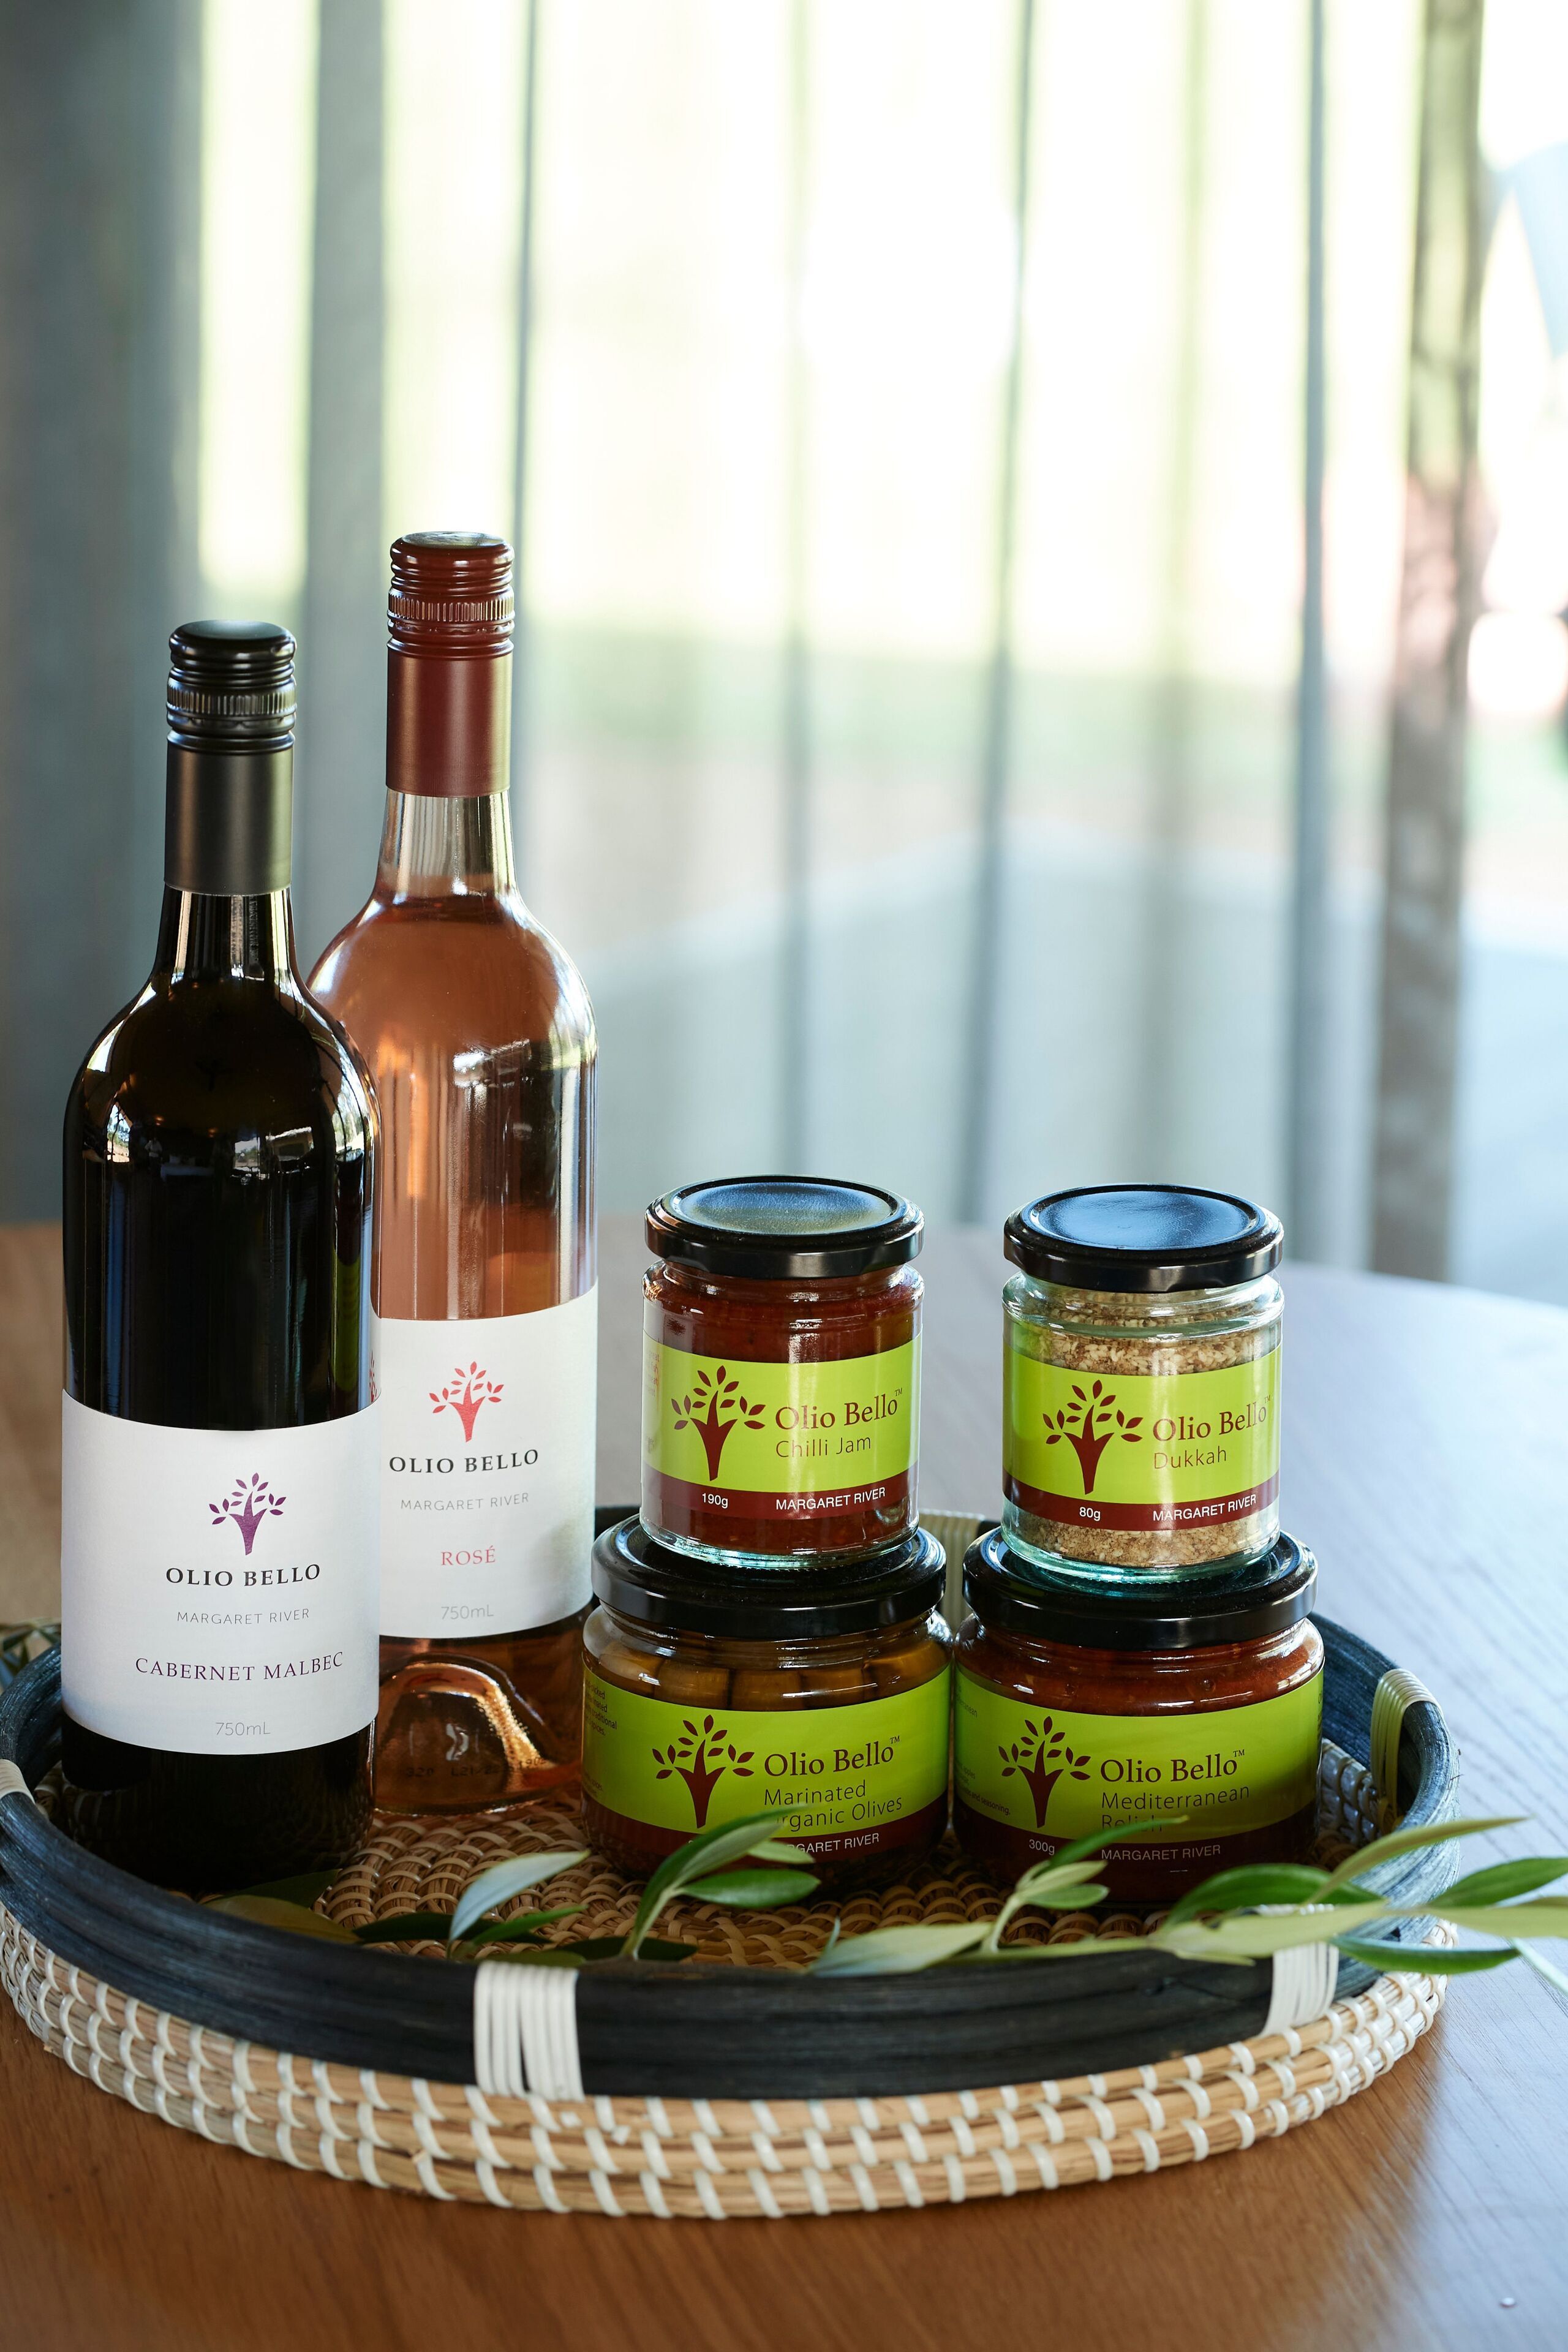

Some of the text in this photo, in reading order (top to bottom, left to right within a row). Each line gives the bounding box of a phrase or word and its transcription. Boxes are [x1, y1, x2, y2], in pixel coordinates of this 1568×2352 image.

[775, 1405, 835, 1430] Olio
[1153, 1416, 1210, 1441] Olio
[776, 1438, 871, 1457] Chilli Jam
[1155, 1446, 1226, 1469] Dukkah
[390, 1450, 538, 1473] OLIO BELLO
[401, 1493, 529, 1510] MARGARET RIVER
[703, 1493, 728, 1509] 190g
[776, 1487, 885, 1510] MARGARET RIVER
[1153, 1494, 1256, 1521] MARGARET RIVER
[1080, 1507, 1100, 1521] 80g
[441, 1545, 496, 1565] ROSÉ
[167, 1564, 320, 1586] OLIO BELLO
[178, 1608, 309, 1624] MARGARET RIVER
[441, 1605, 494, 1619] 750mL
[136, 1652, 343, 1680] CABERNET MALBEC
[216, 1722, 270, 1735] 750mL
[764, 1752, 824, 1777] Olio
[1101, 1758, 1161, 1783] Olio
[765, 1779, 865, 1806] Marinated
[1102, 1786, 1249, 1809] Mediterranean
[777, 1797, 902, 1831] rganic Olives
[845, 1833, 878, 1849] RIVER
[1029, 1839, 1055, 1855] 300g
[1101, 1845, 1220, 1861] MARGARET RIVER
